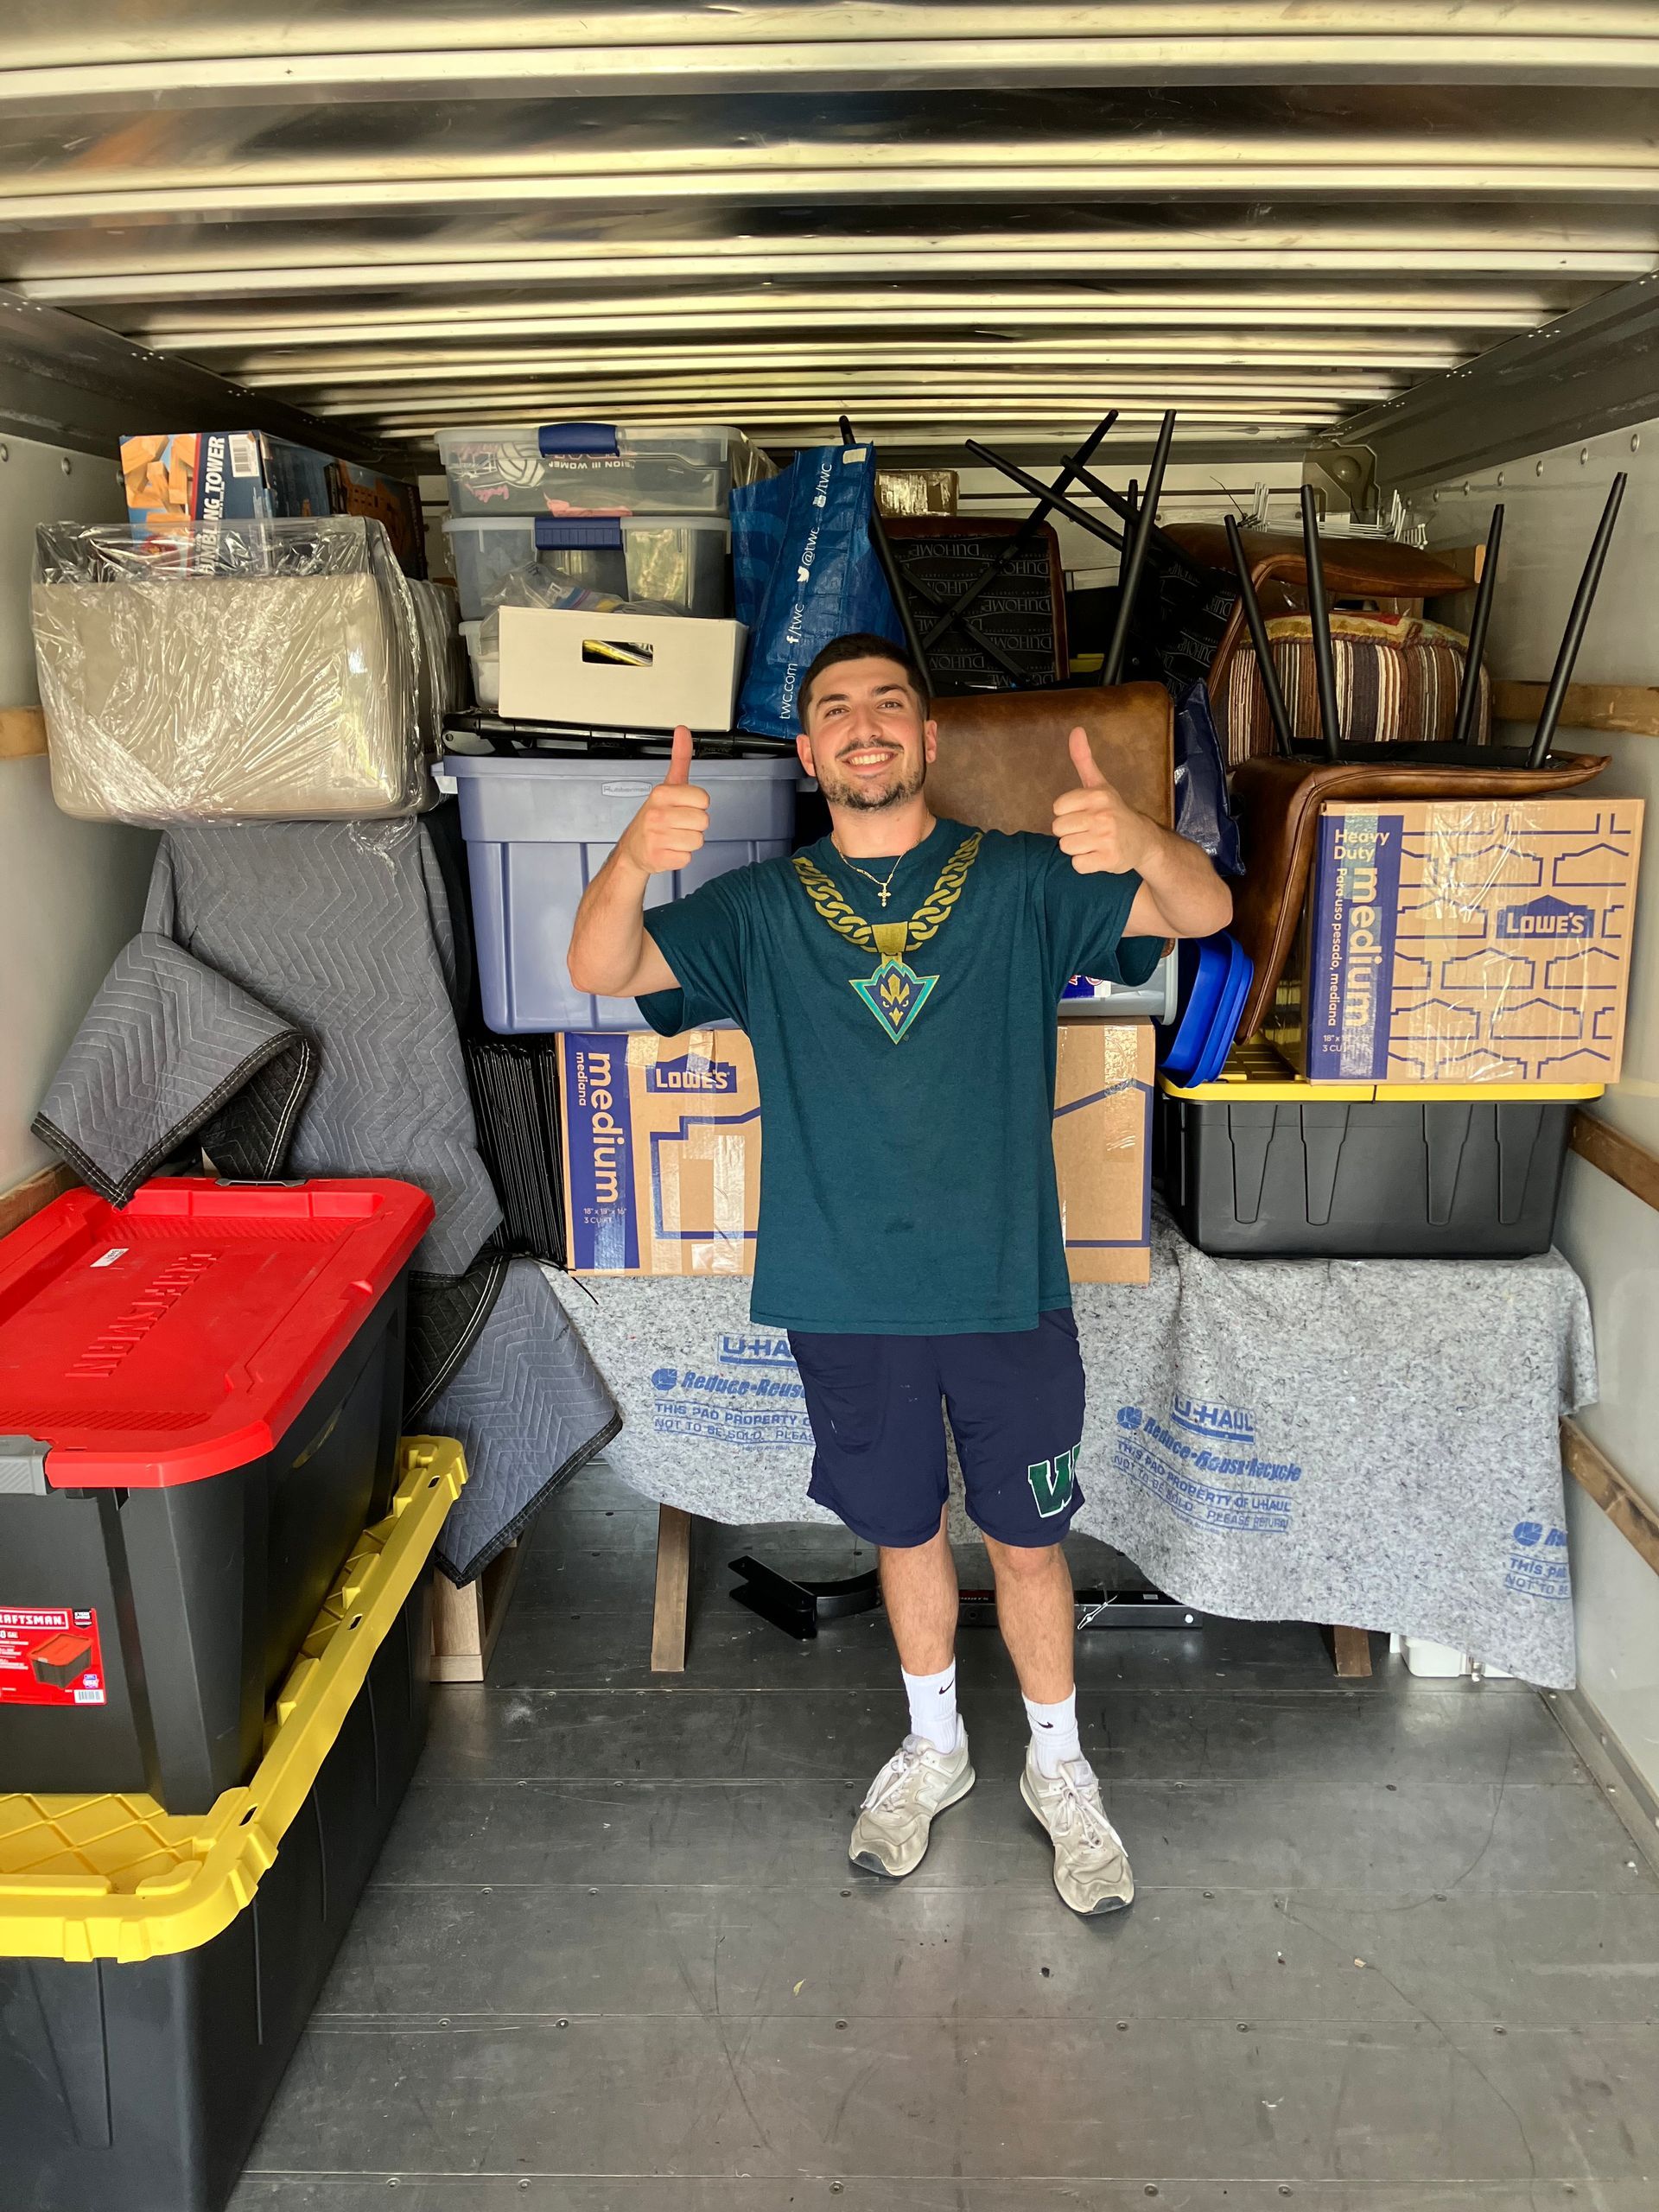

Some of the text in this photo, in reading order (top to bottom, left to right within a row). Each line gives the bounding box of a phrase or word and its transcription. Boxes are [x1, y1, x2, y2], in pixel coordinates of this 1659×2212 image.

[205, 435, 226, 493] TOWER
[910, 543, 980, 556] DUHOME
[982, 599, 1051, 613] DUHOME
[779, 663, 798, 720] twc.com
[802, 526, 820, 566] @twc
[1335, 830, 1389, 846] Heavy
[1334, 846, 1376, 861] Duty
[1506, 912, 1585, 934] LOWE'S
[1327, 868, 1347, 1027] Para uso pesado, mediana
[1344, 868, 1382, 1027] medium
[575, 1052, 588, 1106] mediana
[656, 1068, 728, 1090] LOWE'S
[588, 1052, 625, 1203] medium
[655, 1403, 687, 1415] THIS
[692, 1407, 719, 1421] PAD
[725, 1411, 798, 1427] PROPERTY
[1174, 1395, 1254, 1432] U-HAUL
[654, 1418, 681, 1430] NOT
[687, 1421, 701, 1432] TO
[707, 1425, 721, 1436] BE
[1118, 1440, 1143, 1460] THIS
[1145, 1454, 1166, 1476] PAD
[1166, 1472, 1232, 1507] PROPERTY
[1235, 1497, 1249, 1508] OF
[1114, 1454, 1135, 1471] NOT
[1138, 1469, 1149, 1483] TO
[1206, 1510, 1249, 1526] PLEASE
[1510, 1557, 1543, 1575] THIS
[1504, 1573, 1534, 1590] NOT
[1539, 1583, 1554, 1594] TO
